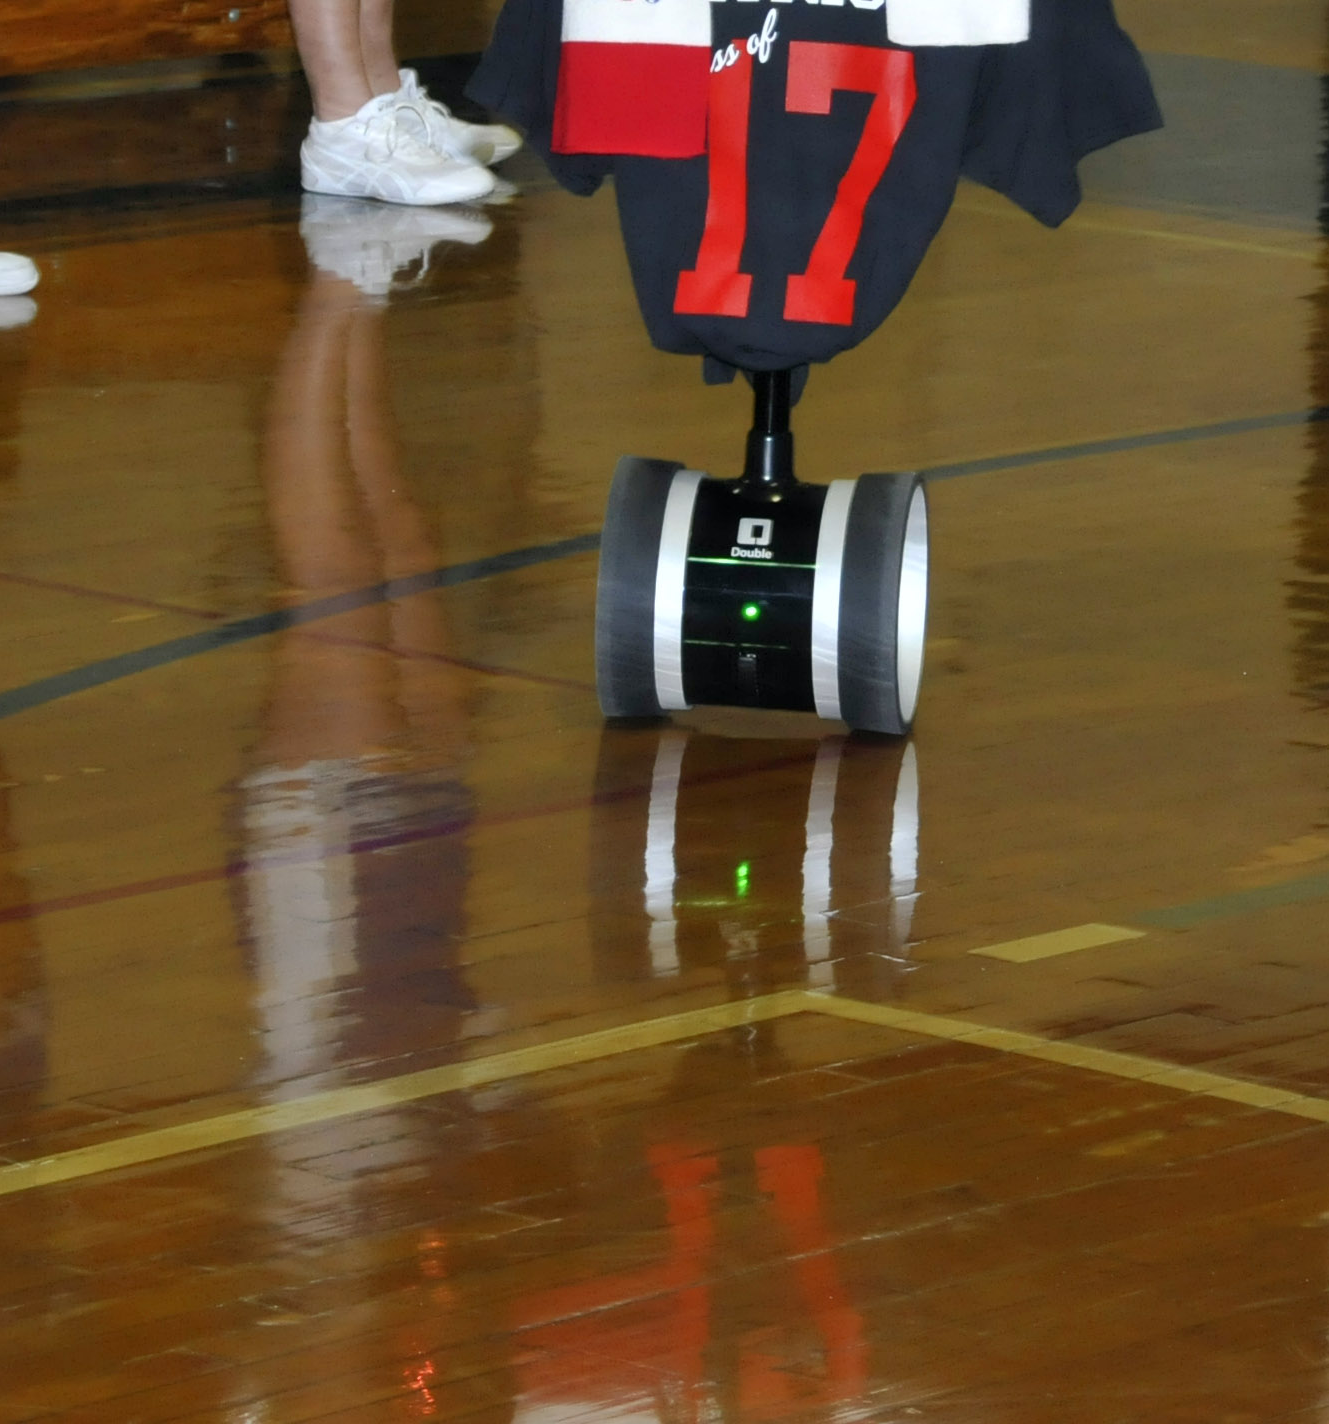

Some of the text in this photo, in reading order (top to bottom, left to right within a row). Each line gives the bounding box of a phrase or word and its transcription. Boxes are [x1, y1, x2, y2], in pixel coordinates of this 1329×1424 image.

[710, 8, 778, 73] ss of
[673, 38, 918, 326] 17
[730, 546, 775, 560] Double
